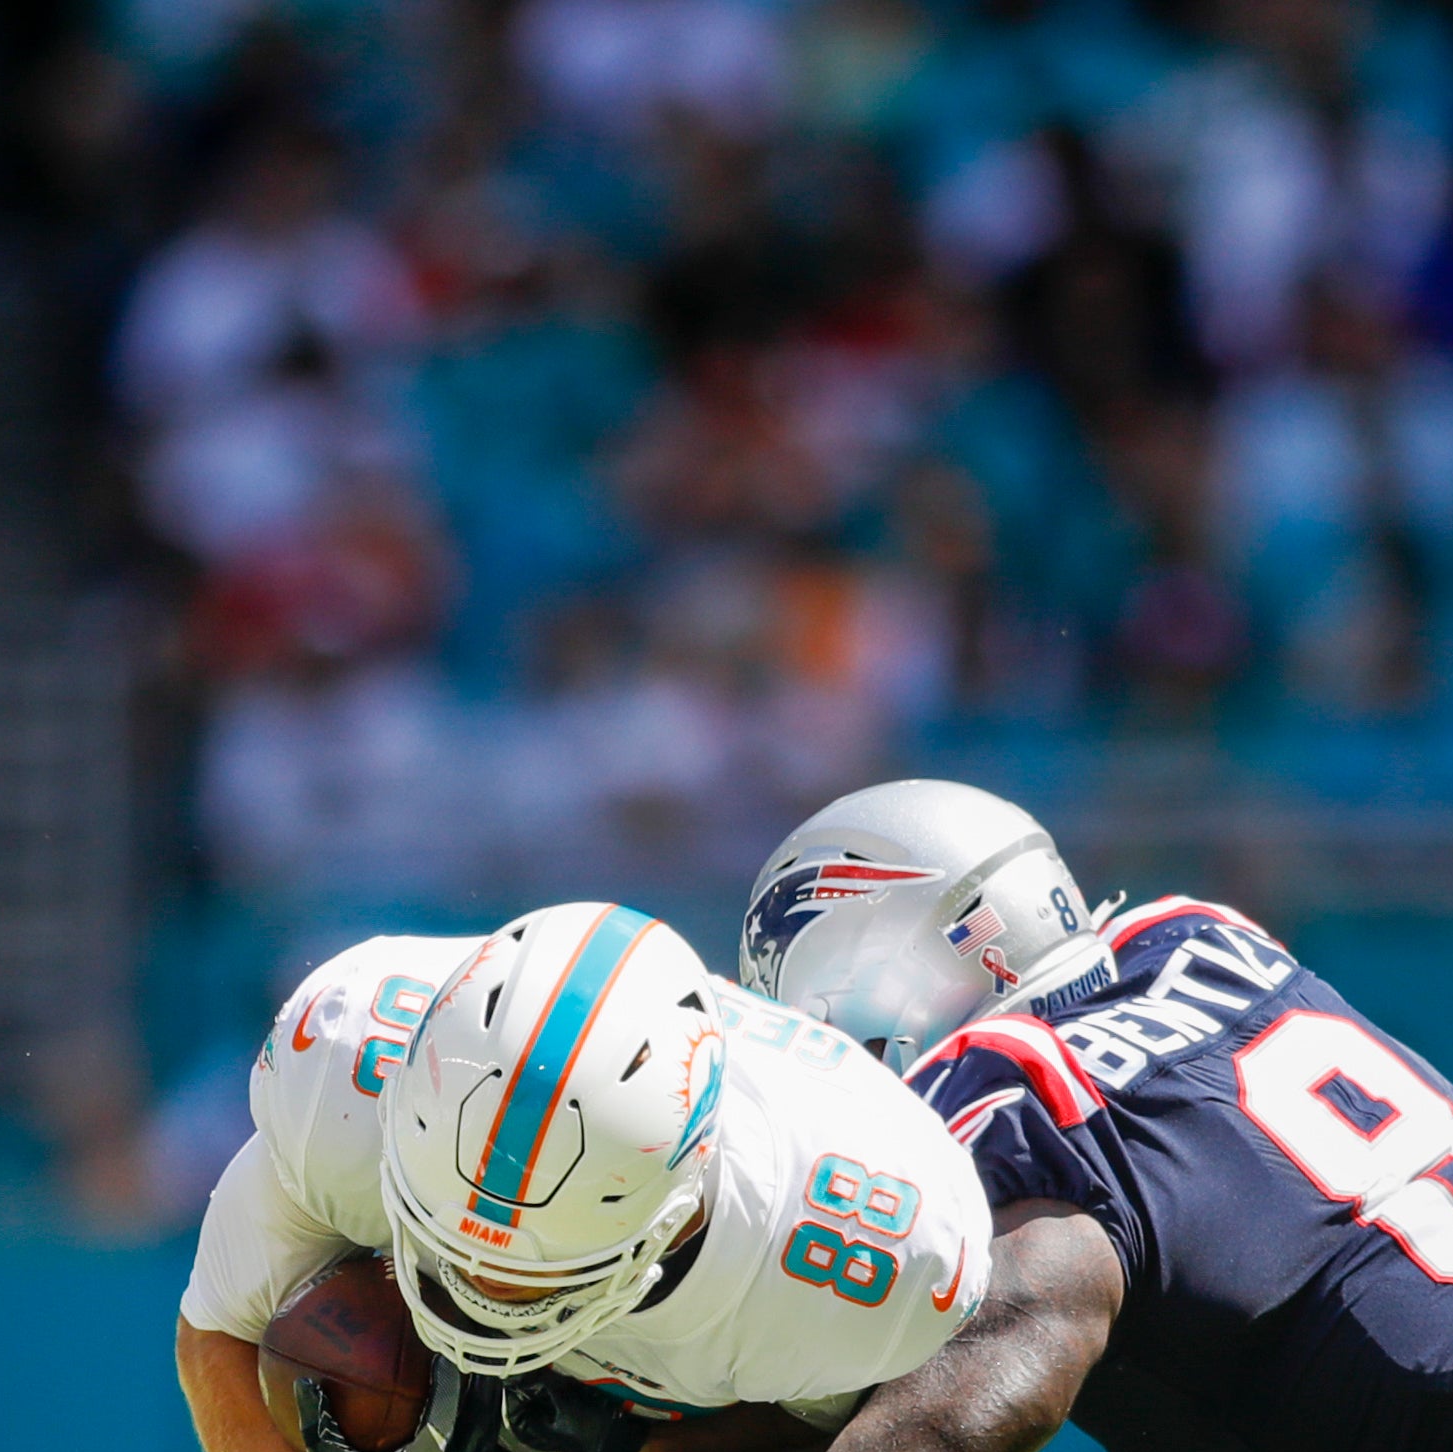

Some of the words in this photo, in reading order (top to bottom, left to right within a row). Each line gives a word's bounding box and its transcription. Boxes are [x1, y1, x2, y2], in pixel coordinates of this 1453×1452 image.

[1050, 887, 1079, 933] 8
[458, 1216, 513, 1249] MIAMI
[781, 1152, 922, 1308] 88
